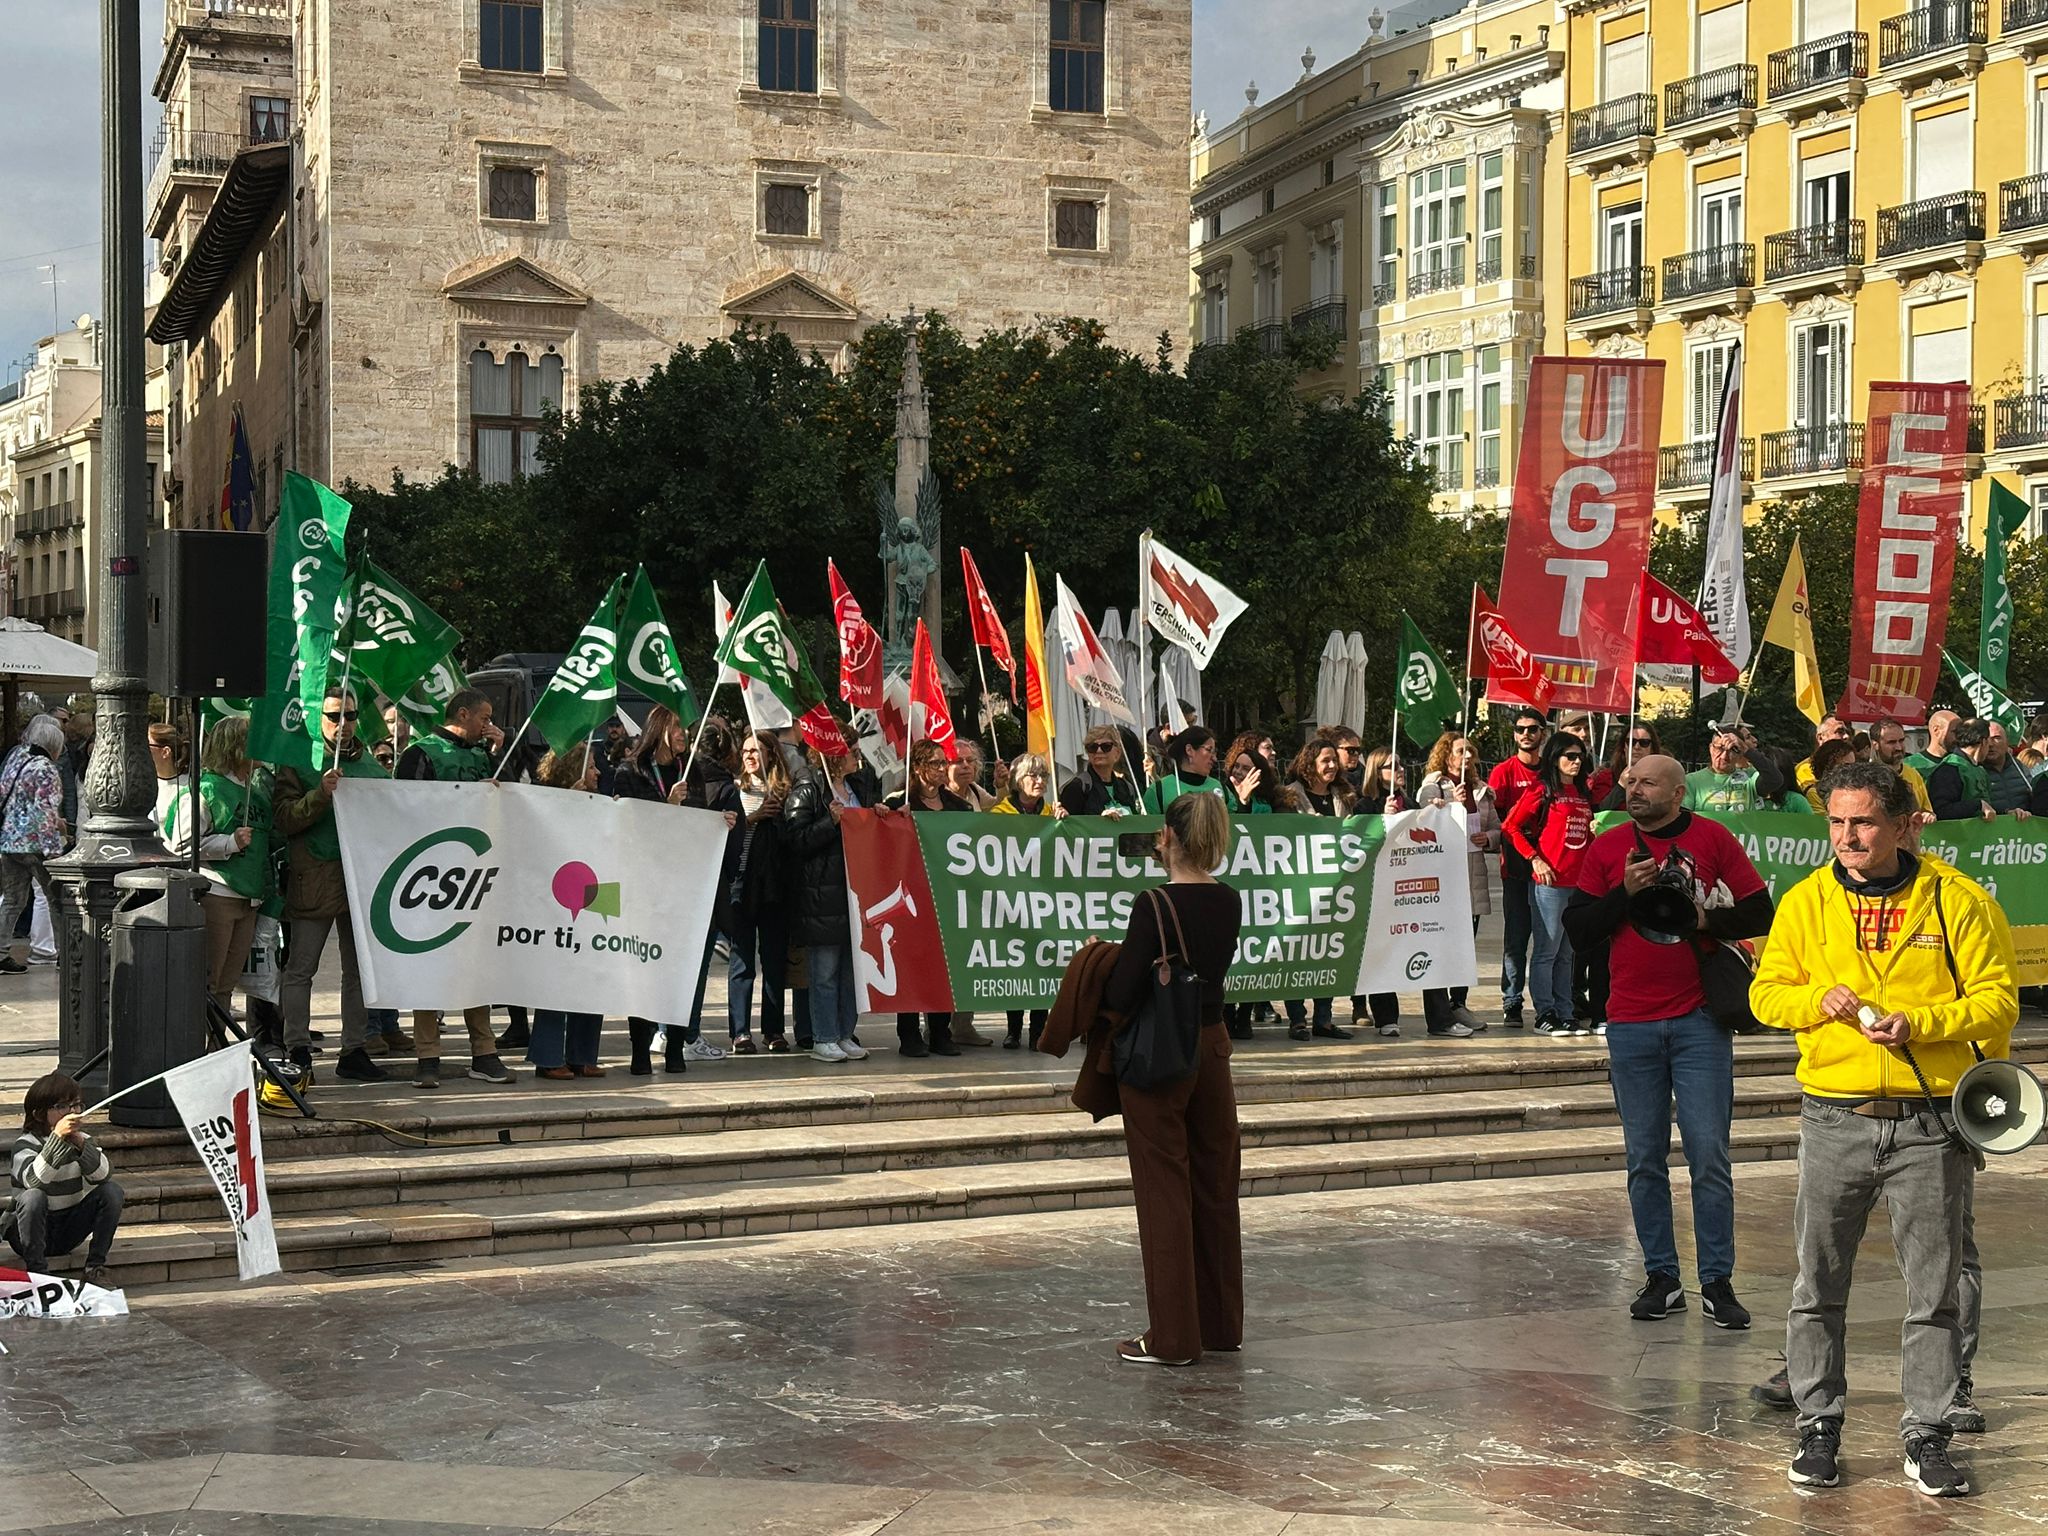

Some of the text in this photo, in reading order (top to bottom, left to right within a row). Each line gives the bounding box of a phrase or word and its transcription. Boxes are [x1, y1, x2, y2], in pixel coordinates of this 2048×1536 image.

[1545, 373, 1628, 637] UGT
[1872, 412, 1947, 656] CCOO
[356, 595, 417, 644] CSIF
[753, 625, 793, 688] CSIF
[1482, 617, 1529, 668] UGT
[649, 637, 687, 693] CSIF
[946, 832, 1041, 878] SOM
[1389, 857, 1407, 868] STAS
[1390, 844, 1444, 858] INTERSINDICAL
[1970, 837, 2047, 866] -ràtios
[399, 865, 500, 911] CSIF
[1394, 891, 1440, 907] educació
[1396, 882, 1423, 893] CCOO
[957, 889, 968, 929] I
[497, 924, 663, 963] por ti, contigo
[1390, 923, 1408, 936] UGT
[966, 938, 1026, 968] ALS
[1410, 959, 1433, 972] CSIF
[973, 978, 1036, 998] PERSONAL
[1283, 972, 1289, 988] I
[1291, 968, 1337, 988] SERVEIS
